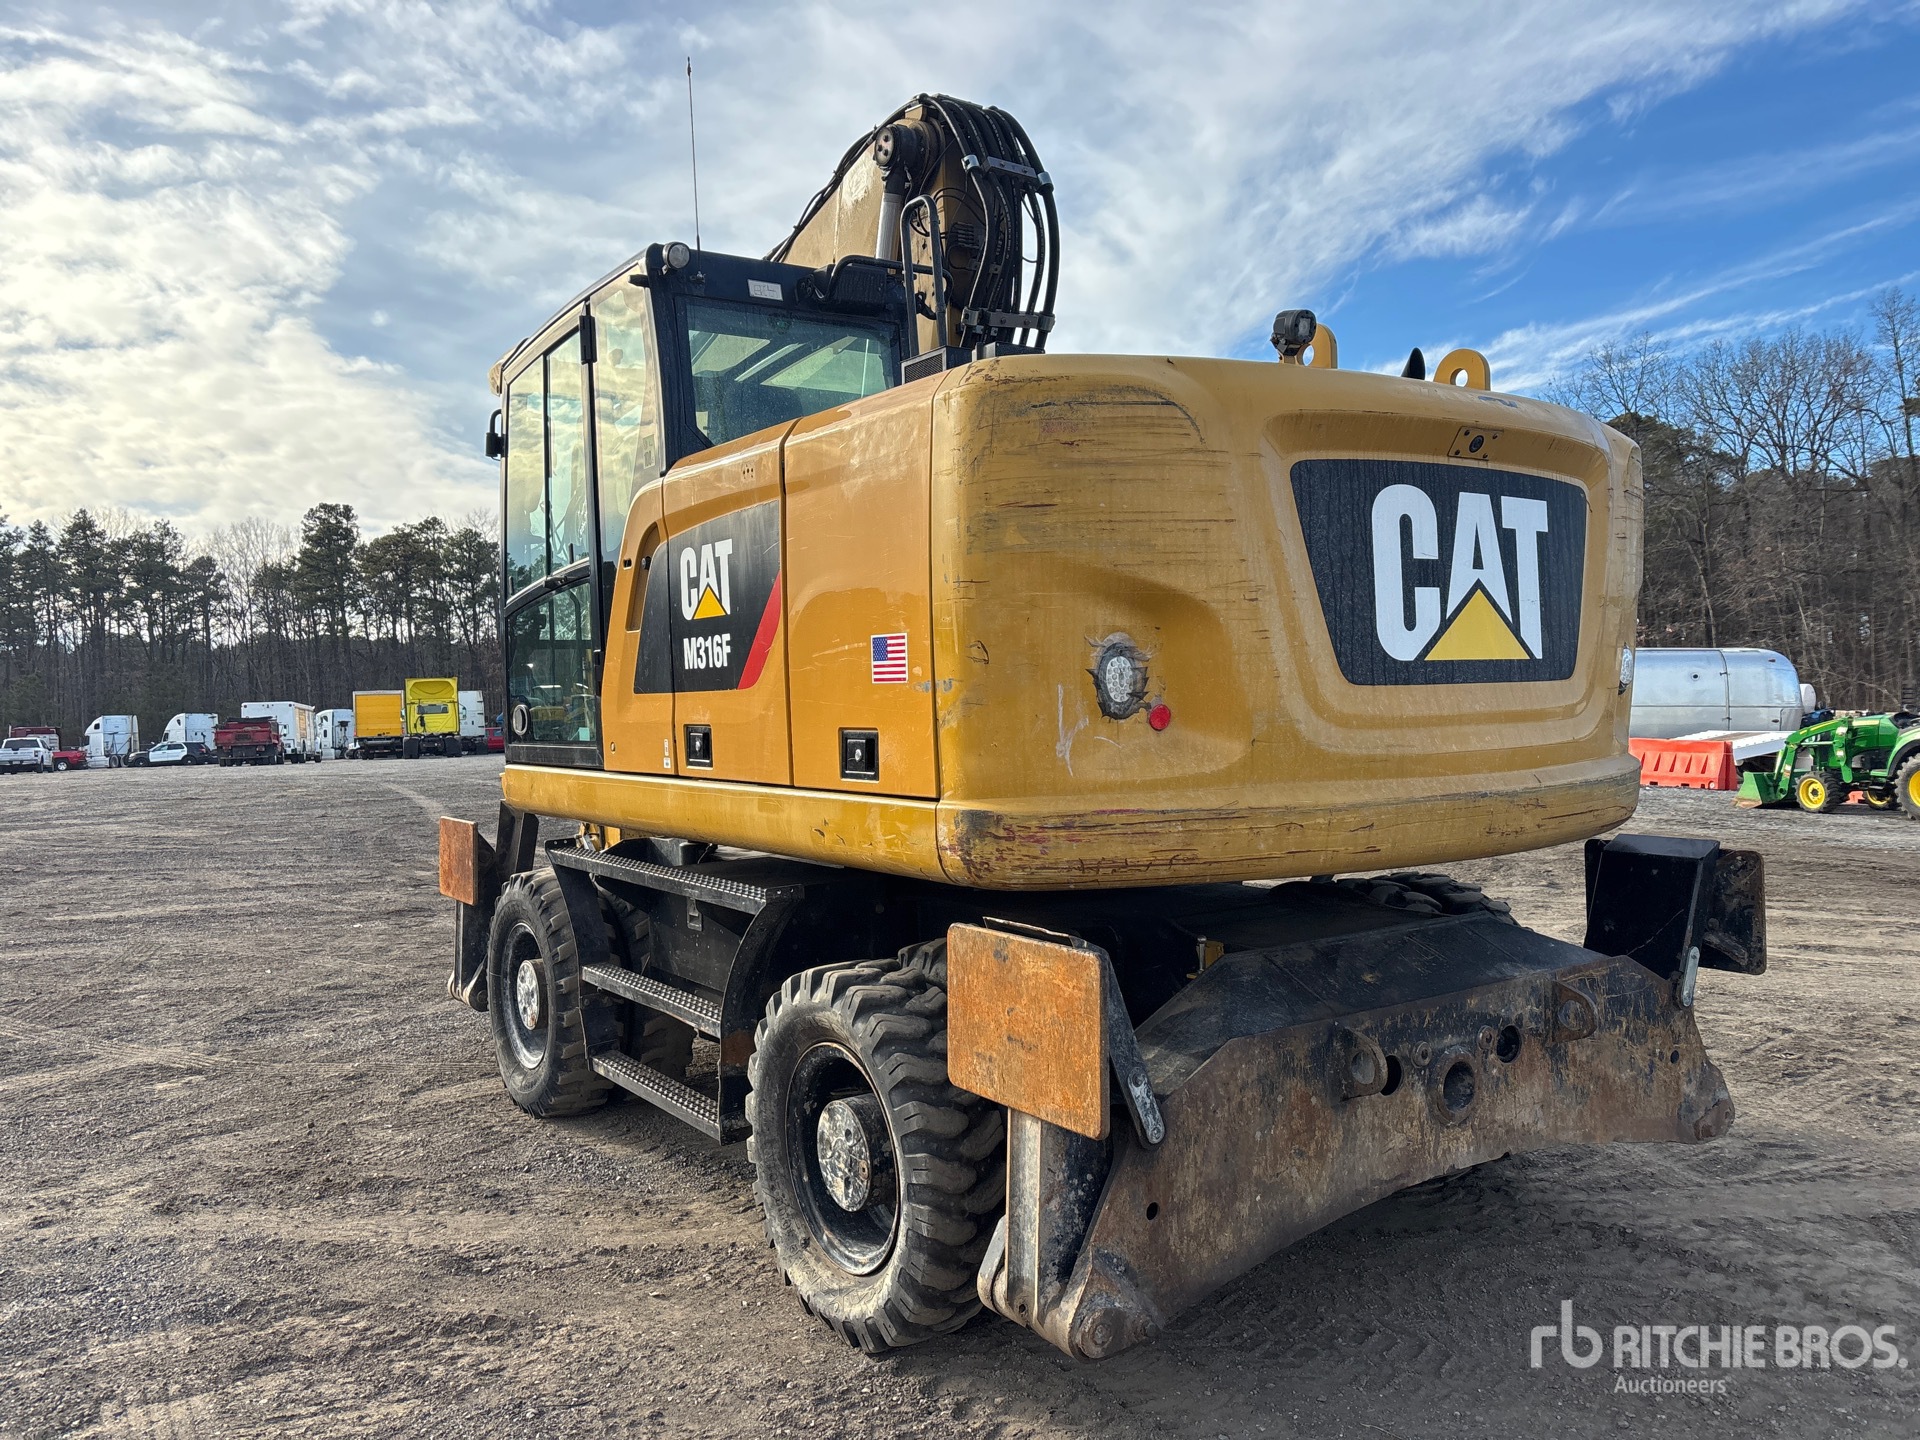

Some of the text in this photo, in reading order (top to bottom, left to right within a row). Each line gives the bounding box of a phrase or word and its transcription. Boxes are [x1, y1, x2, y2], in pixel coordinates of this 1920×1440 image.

[680, 538, 733, 621] CAT
[1371, 483, 1549, 661] CAT
[683, 633, 732, 670] M316F
